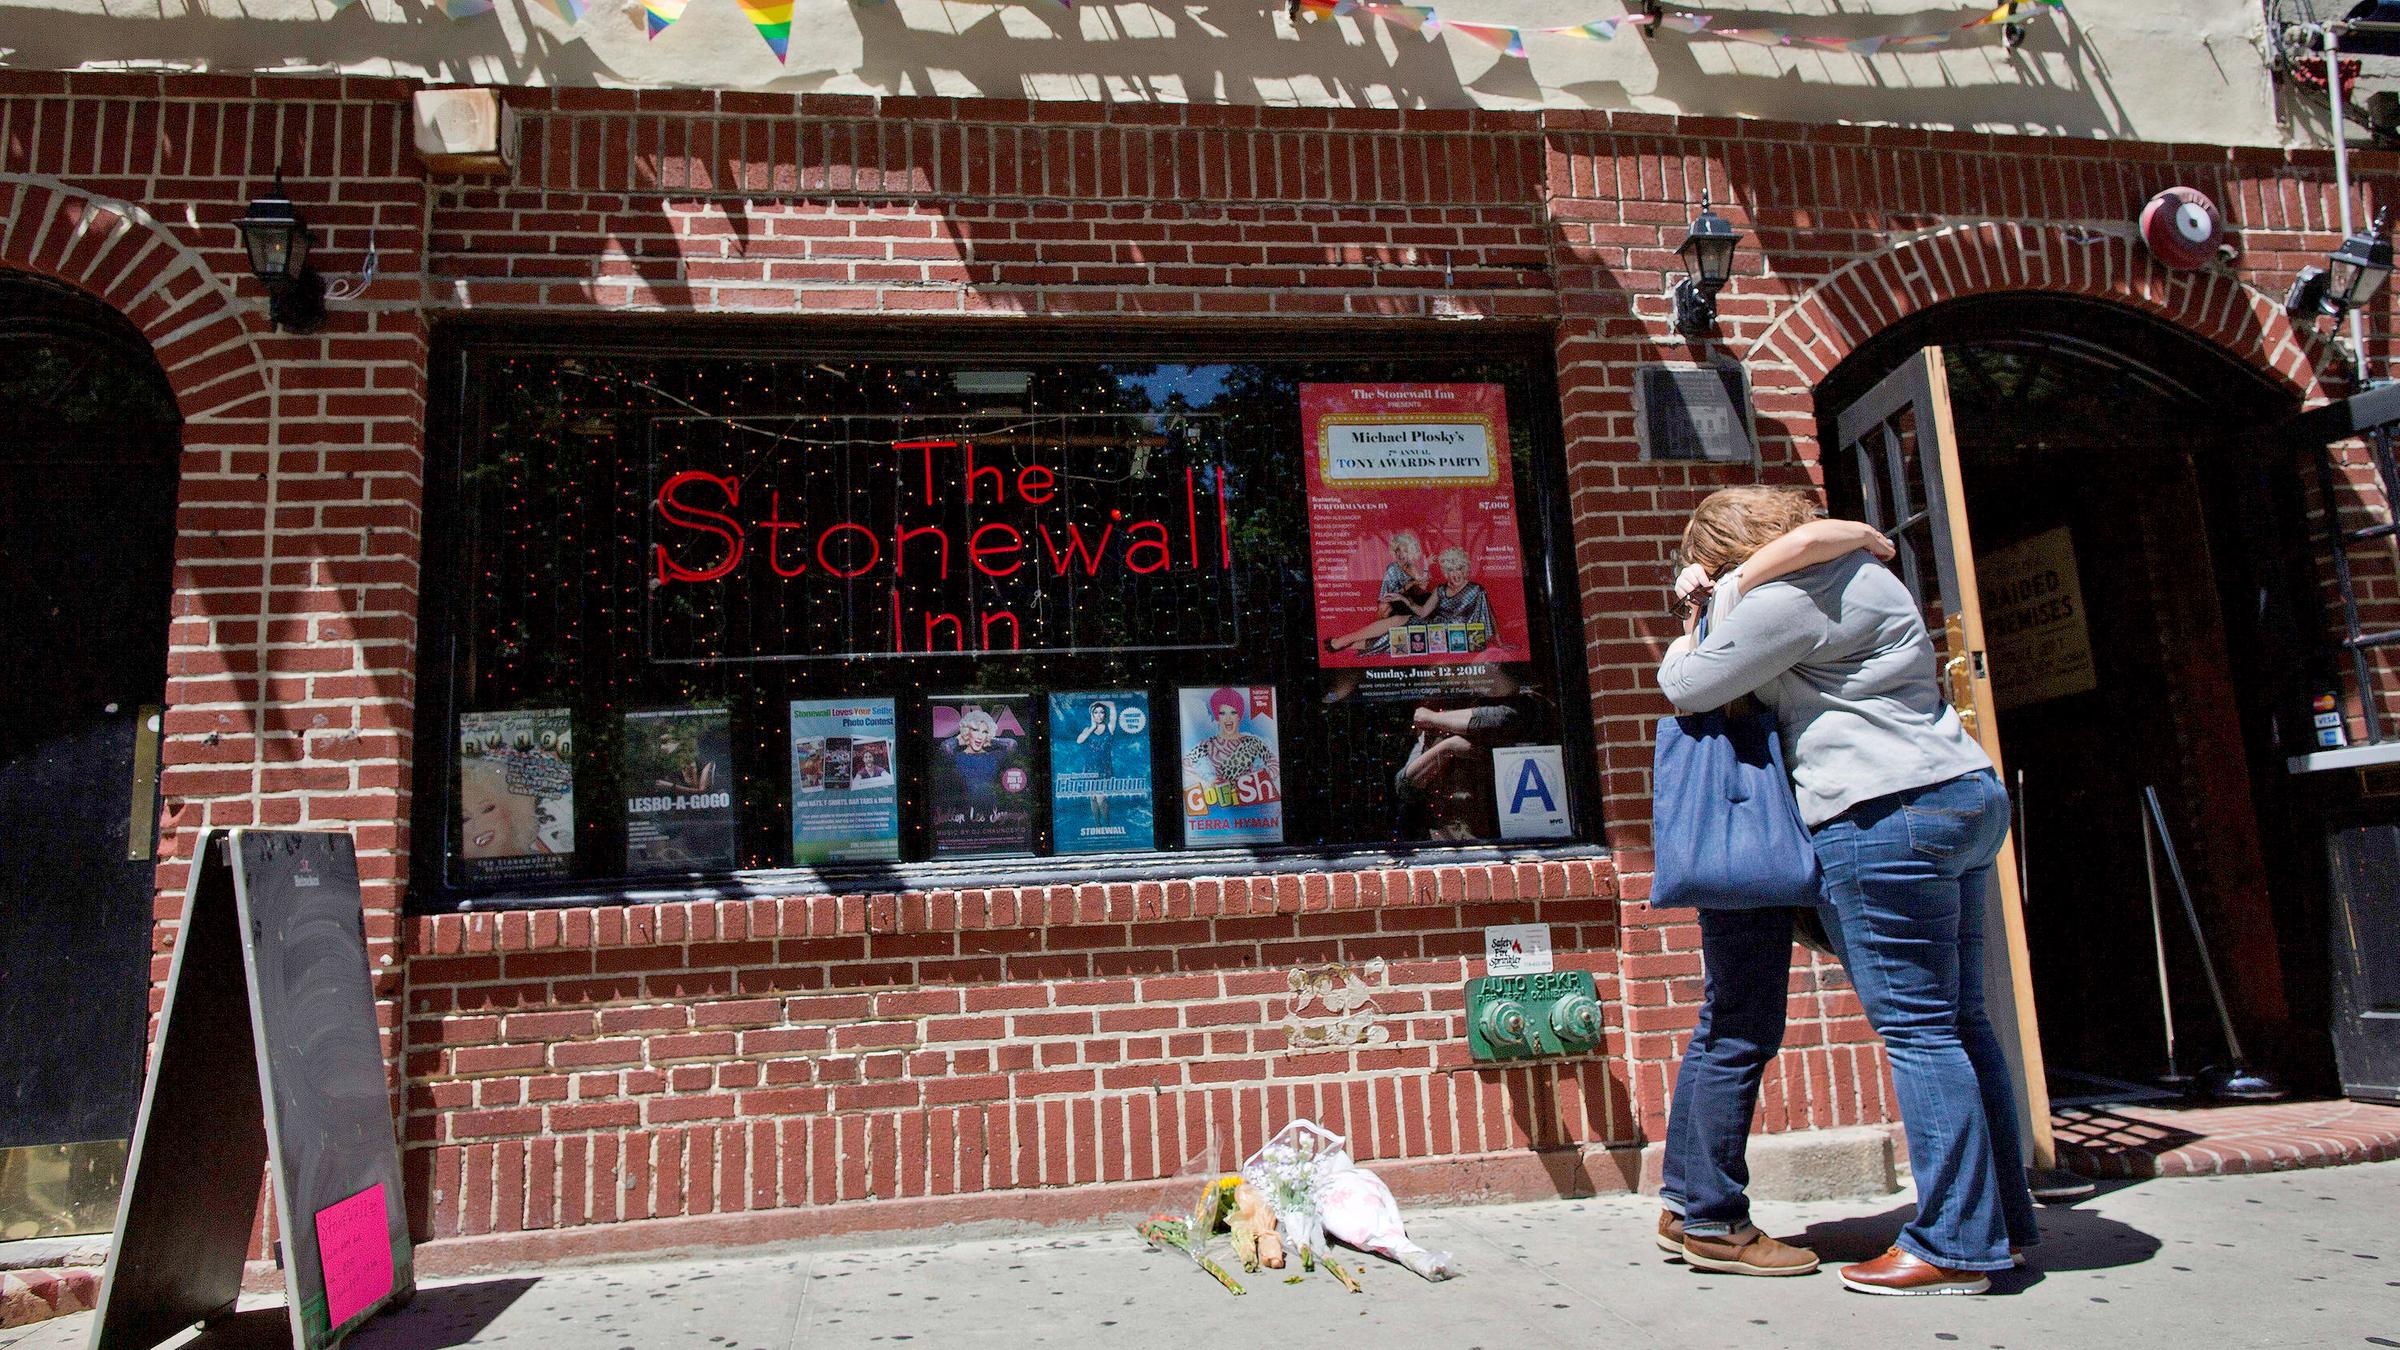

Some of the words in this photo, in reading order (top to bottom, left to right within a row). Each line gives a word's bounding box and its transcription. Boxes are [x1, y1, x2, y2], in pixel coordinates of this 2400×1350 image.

[1351, 388, 1375, 400] The
[1377, 388, 1431, 400] Stonewall
[1434, 389, 1455, 400] Inn
[1351, 431, 1406, 443] Michael
[1411, 430, 1464, 445] Plosky's
[1337, 458, 1375, 468] TONY
[1378, 457, 1436, 468] AWARDS
[1439, 457, 1482, 467] PARTY
[892, 442, 1055, 505] The
[1312, 503, 1377, 511] PERFORMANCES
[1378, 502, 1389, 510] BY
[657, 465, 1229, 586] Stonewall
[893, 590, 1019, 653] Inn
[1366, 668, 1408, 680] Sunday,
[1409, 667, 1436, 678] June
[1457, 665, 1486, 676] 2016
[794, 709, 830, 719] Stonewall
[832, 708, 853, 717] Loves
[853, 707, 871, 715] Your
[872, 706, 893, 715] Selfie
[842, 719, 864, 727] Photo
[865, 717, 893, 726] Contest
[932, 704, 1026, 739] DA
[1510, 758, 1557, 814] A
[628, 792, 730, 813] LESBO-A-GOGO
[1188, 818, 1231, 831] TERRA
[1233, 817, 1279, 829] HYMAN
[1080, 826, 1126, 837] STONEWALL
[1491, 937, 1511, 949] Safety
[1494, 949, 1508, 957] Fire
[1489, 955, 1521, 967] Sprinkler
[1481, 976, 1527, 994] AUTO
[1534, 971, 1581, 990] SPKR
